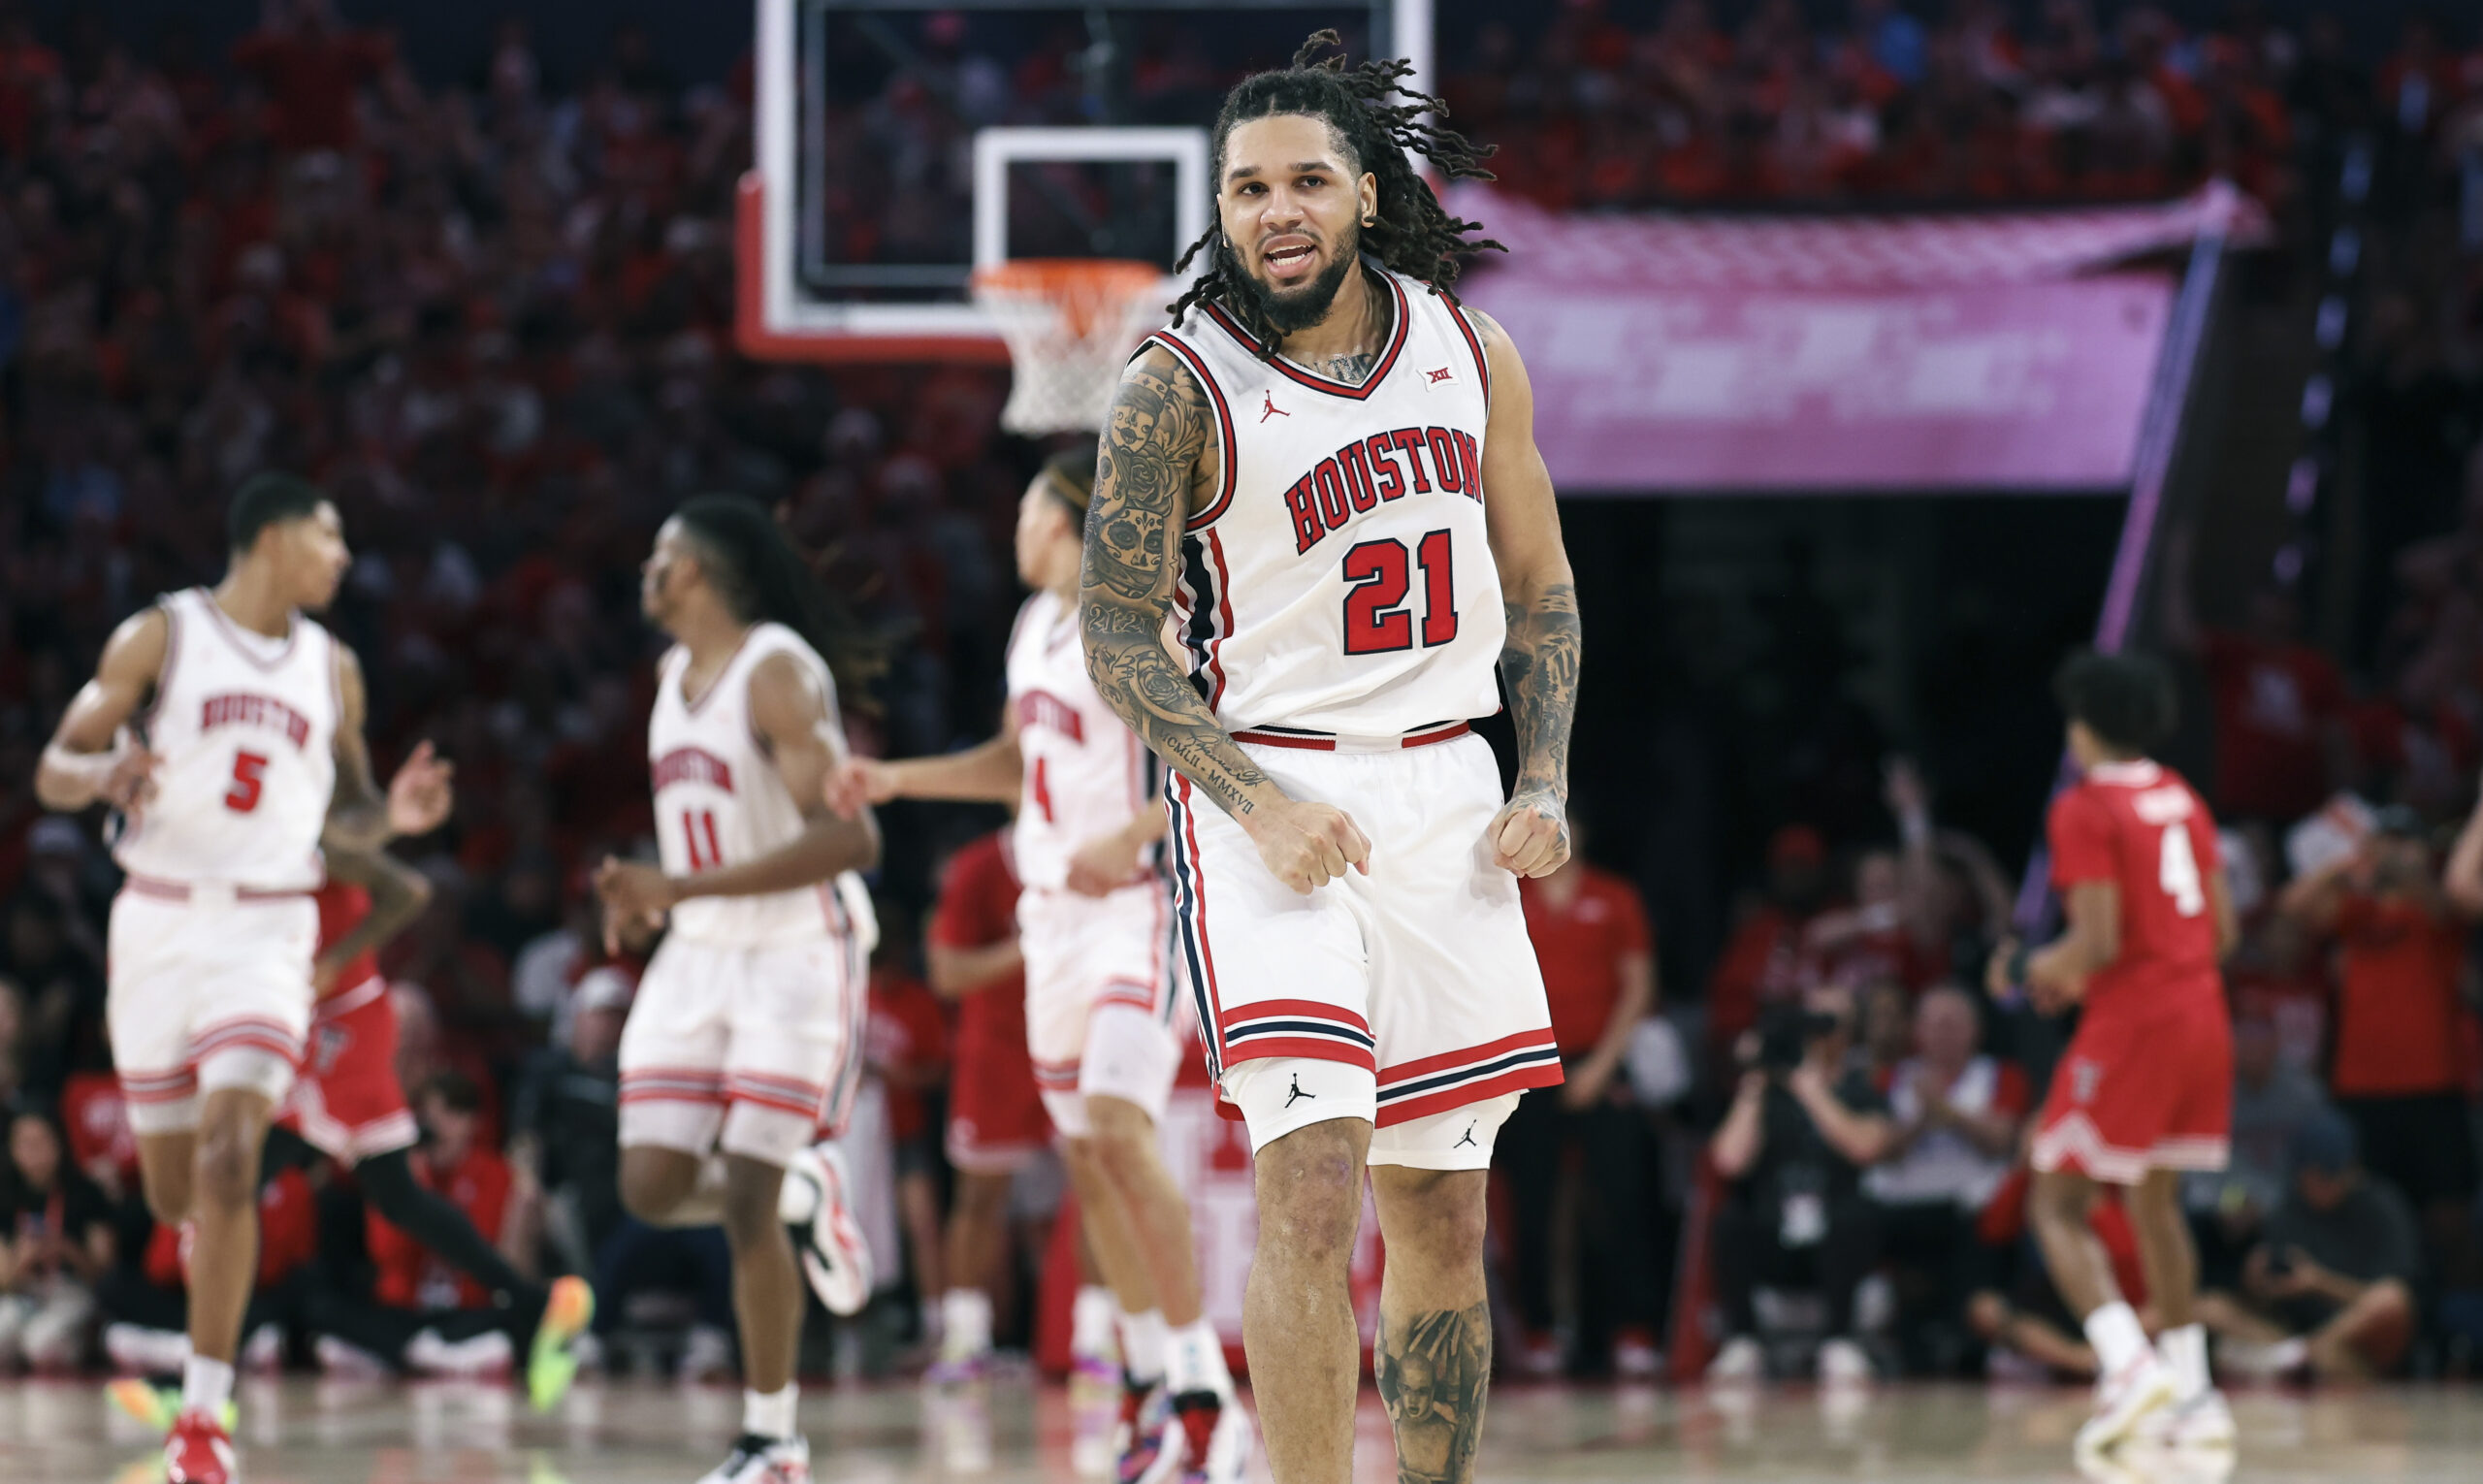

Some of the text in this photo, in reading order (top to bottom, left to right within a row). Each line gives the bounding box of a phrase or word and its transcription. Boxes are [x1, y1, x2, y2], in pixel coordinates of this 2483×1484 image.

[1283, 425, 1483, 557] HOUSTON
[1342, 528, 1459, 657] 21
[224, 751, 269, 813] 5
[1208, 769, 1255, 815] MMXVII
[682, 809, 722, 872] 11
[2159, 823, 2206, 917] 4
